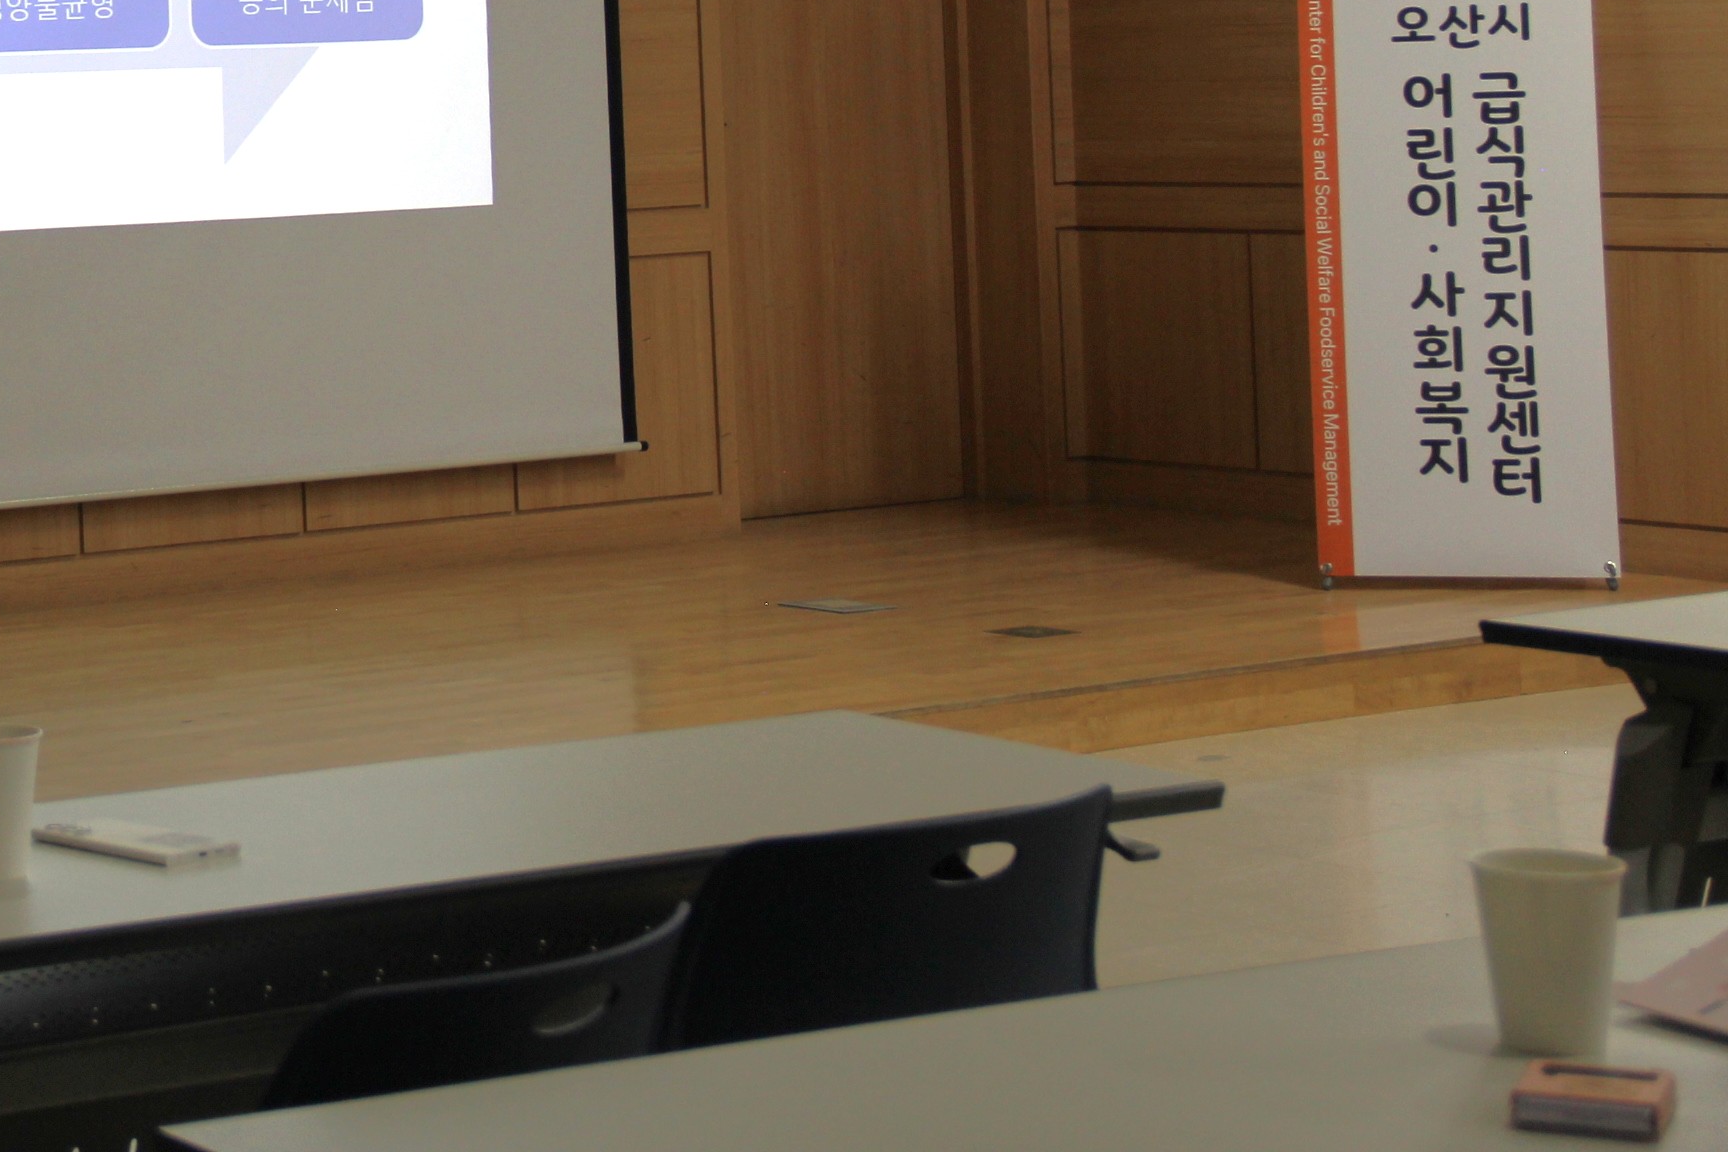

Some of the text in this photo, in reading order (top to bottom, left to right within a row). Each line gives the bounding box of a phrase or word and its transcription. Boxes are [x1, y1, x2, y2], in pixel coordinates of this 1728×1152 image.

[1310, 37, 1326, 61] for
[1391, 2, 1530, 49] 오산시
[1310, 64, 1330, 147] Children's
[1313, 149, 1330, 181] and
[1314, 184, 1333, 234] Social
[1316, 236, 1335, 303] Welfare
[1472, 72, 1542, 504] 급식관리지원센터
[1319, 307, 1339, 409] Foodservice
[1323, 413, 1342, 526] Management
